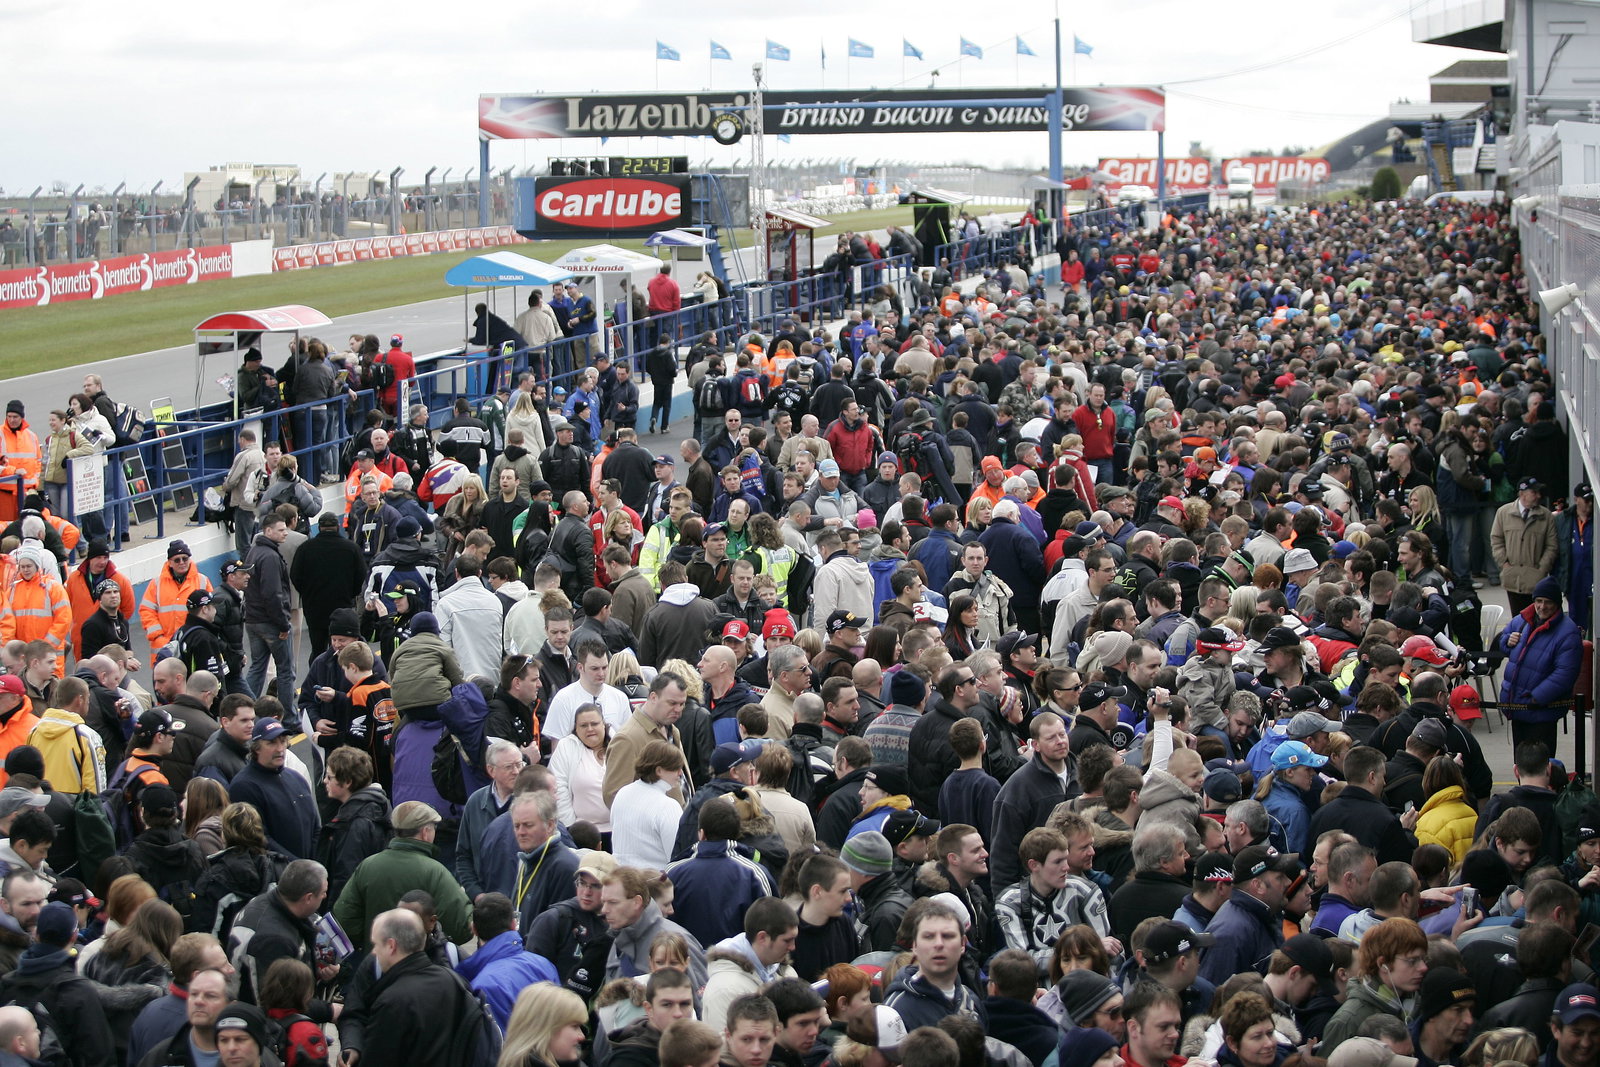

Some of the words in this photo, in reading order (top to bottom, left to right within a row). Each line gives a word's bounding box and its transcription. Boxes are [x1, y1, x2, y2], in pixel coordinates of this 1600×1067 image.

[872, 101, 954, 125] Bacon
[983, 106, 1090, 130] Sausge
[1102, 159, 1209, 185] Carlube
[1225, 160, 1327, 186] Carlube
[541, 190, 681, 217] Carlube
[103, 261, 141, 288] bennetts
[153, 256, 188, 280] bennetts
[198, 252, 232, 275] bennetts
[51, 269, 91, 295] bennetts
